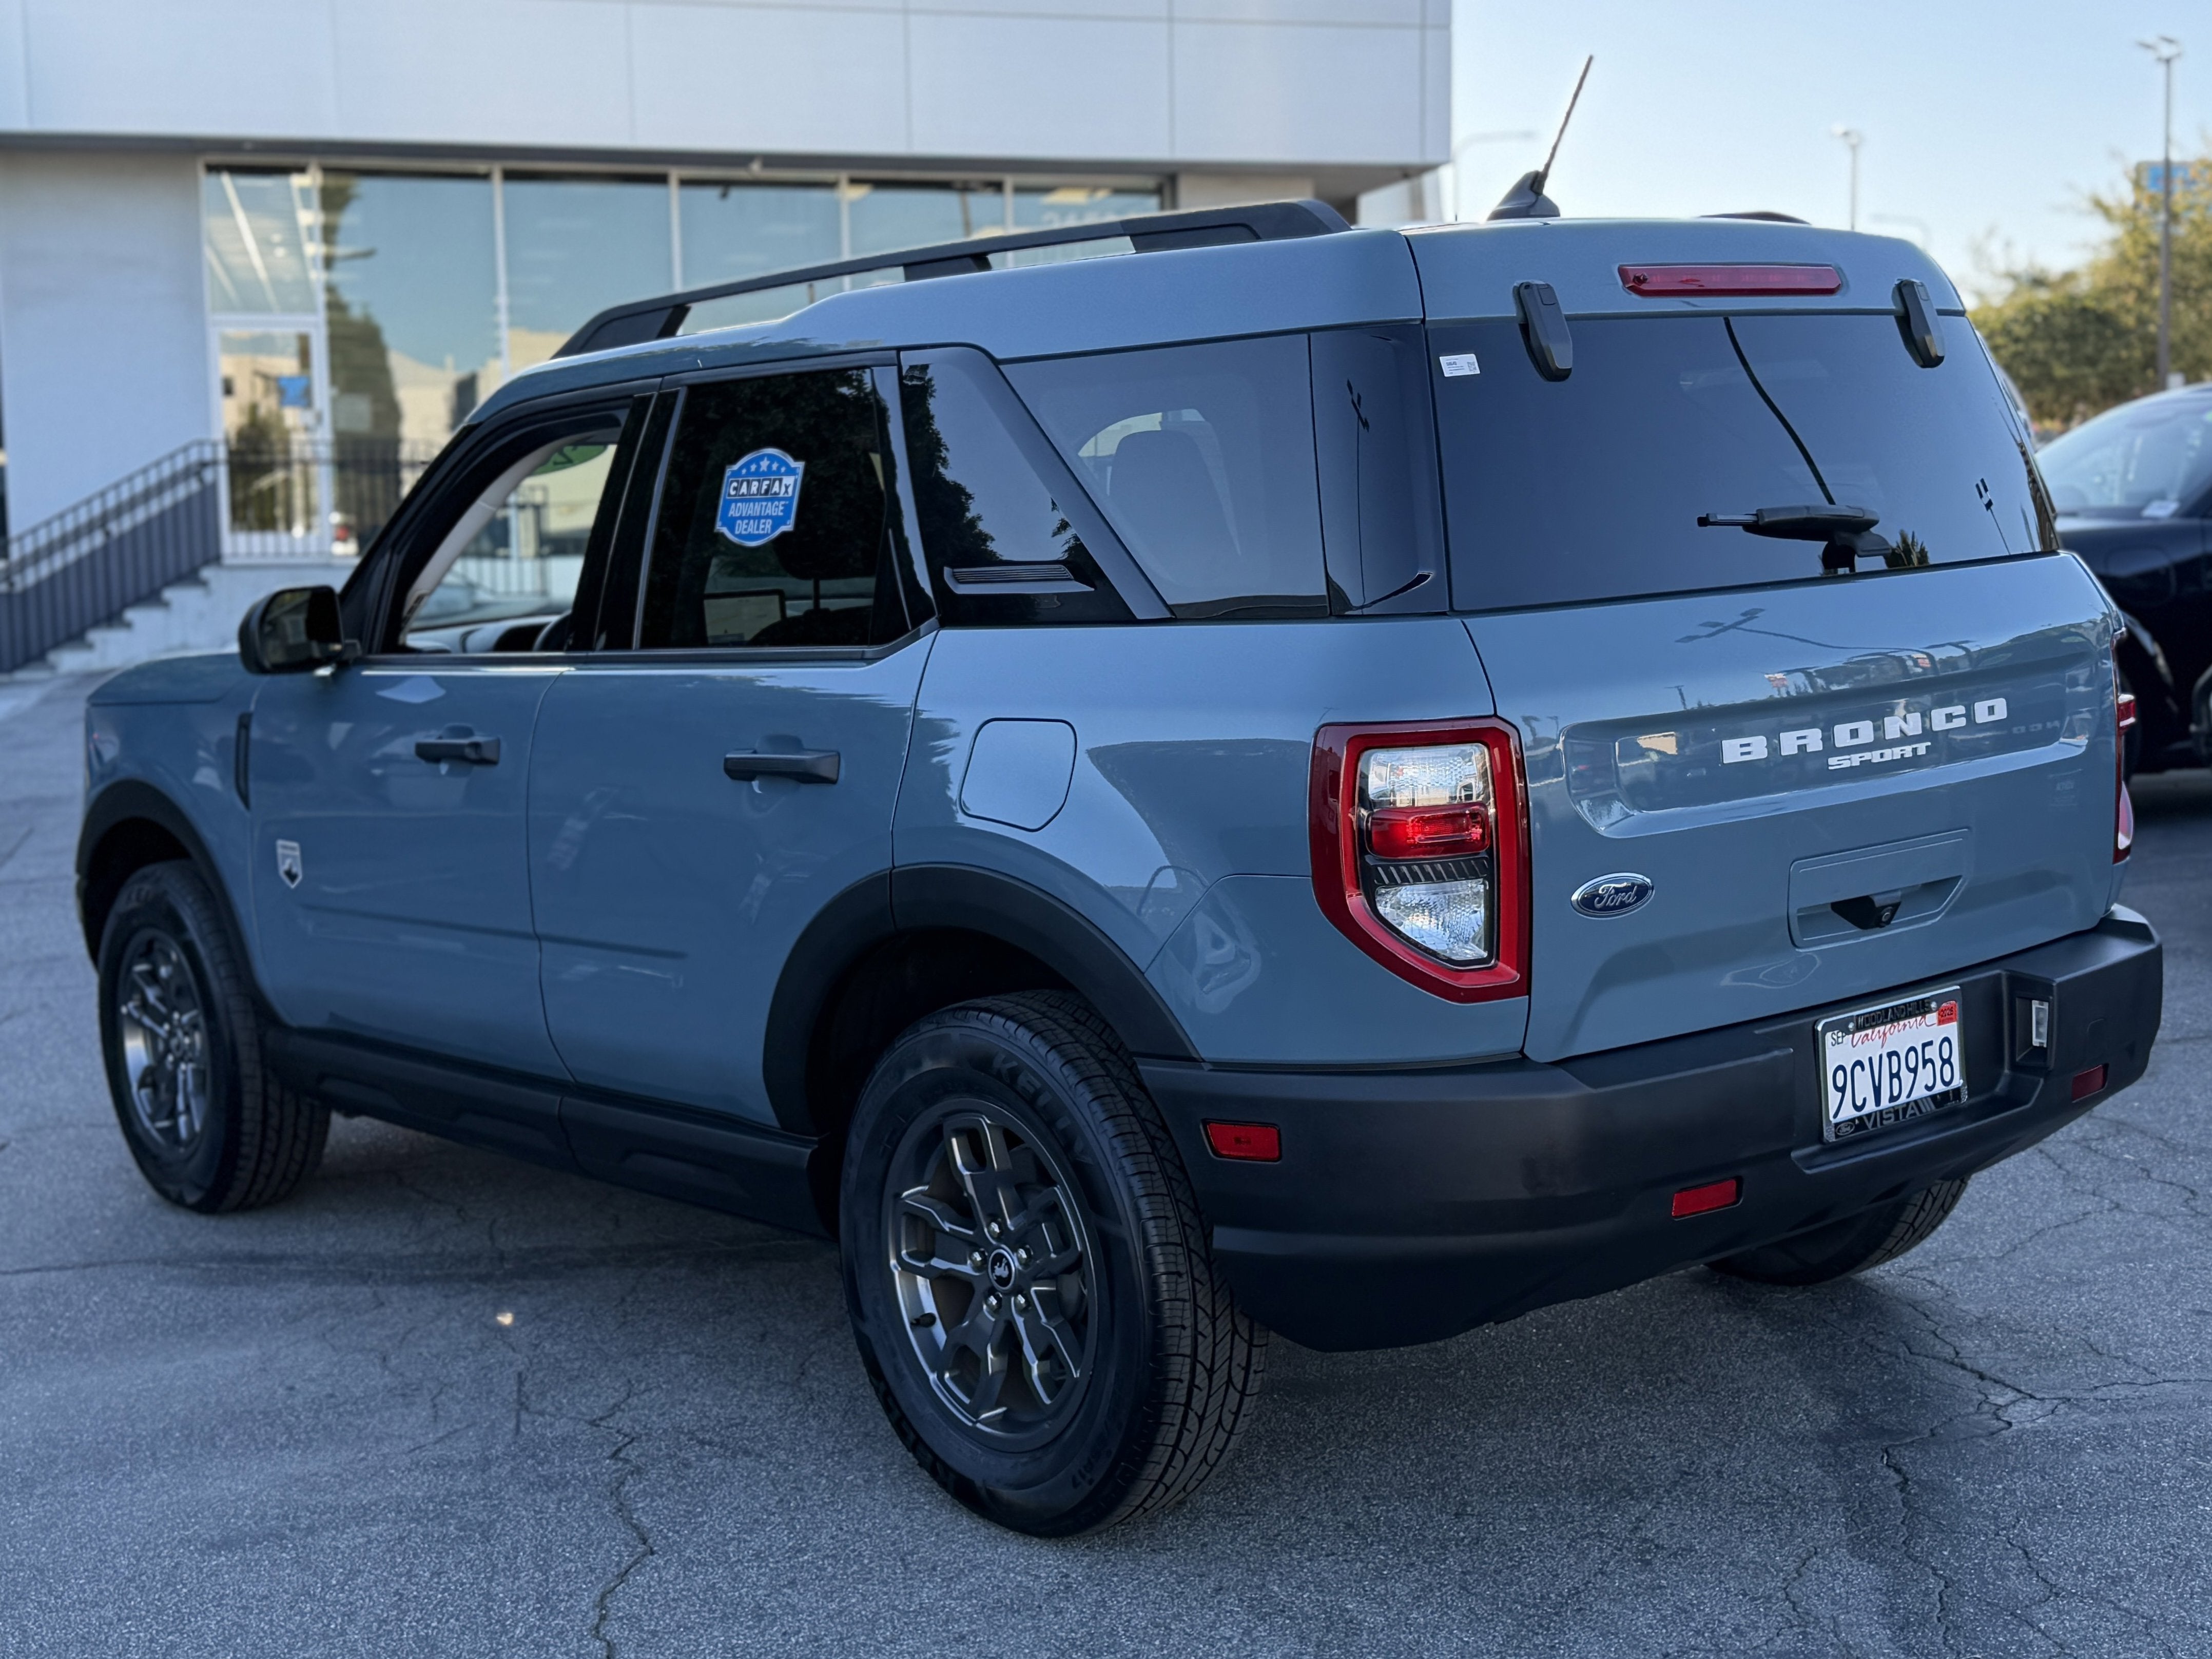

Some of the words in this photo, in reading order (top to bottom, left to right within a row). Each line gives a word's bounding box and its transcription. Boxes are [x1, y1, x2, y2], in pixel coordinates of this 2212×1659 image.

[729, 479, 791, 496] CARFAX
[728, 501, 785, 517] ADVANTAGE
[734, 519, 772, 534] DEALER
[1721, 698, 2008, 764] BRONCO
[1828, 741, 1932, 770] SPORT
[1594, 882, 1638, 909] Ford
[1858, 1005, 1906, 1028] WOODLAND
[1907, 998, 1931, 1015] HILLS
[1832, 1036, 1955, 1120] 9CVB958
[1862, 1102, 1922, 1130] VISTA
